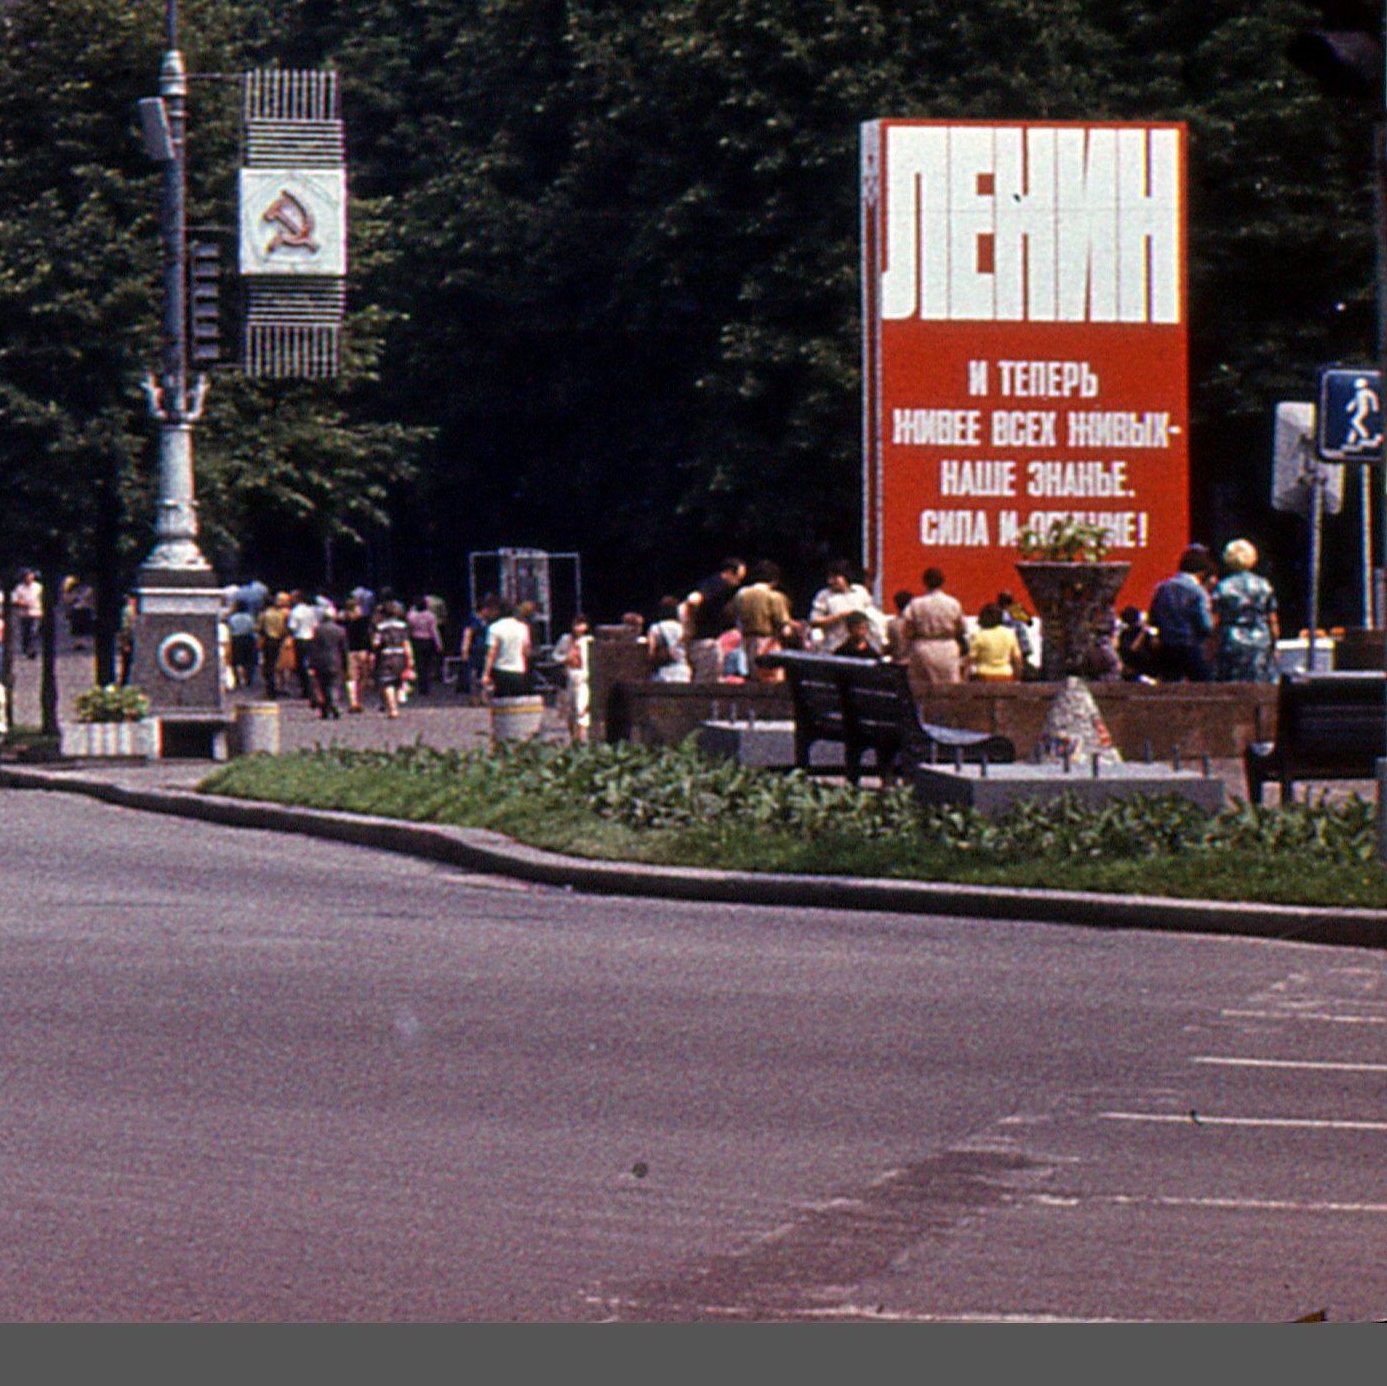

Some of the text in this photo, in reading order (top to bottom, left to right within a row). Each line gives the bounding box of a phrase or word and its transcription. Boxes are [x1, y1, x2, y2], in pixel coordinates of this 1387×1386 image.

[882, 126, 1180, 324] ЛЕНИН
[968, 360, 1098, 397] И ТЕПЕРЬ
[892, 409, 981, 446] ЖИВЕЕ
[992, 410, 1057, 446] ВСЕХ
[940, 460, 1017, 496] НАШЕ
[920, 511, 990, 546] СИЛА
[999, 511, 1019, 546] И
